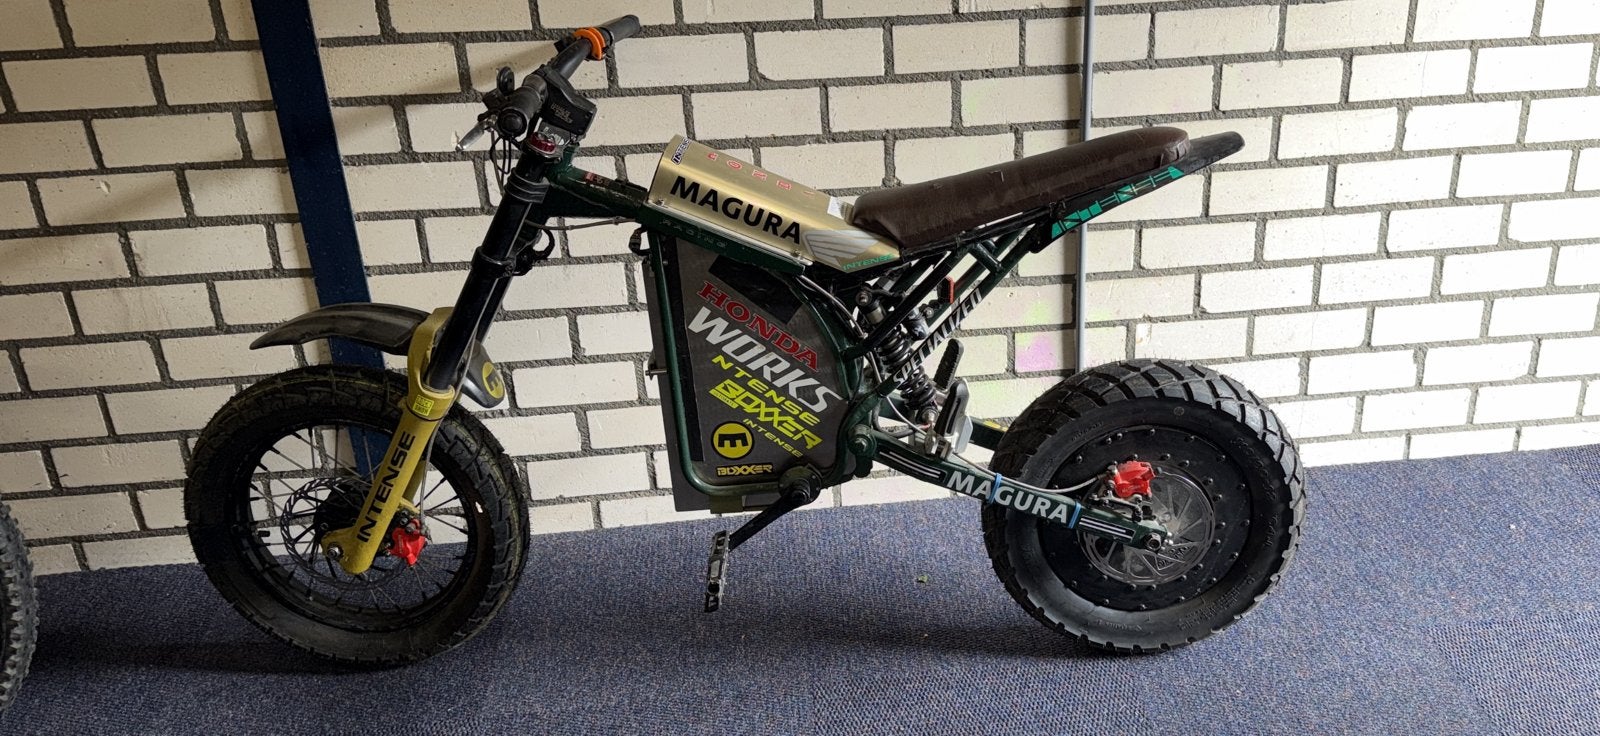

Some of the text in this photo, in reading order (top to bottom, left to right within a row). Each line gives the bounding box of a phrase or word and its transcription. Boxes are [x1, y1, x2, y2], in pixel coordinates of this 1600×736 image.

[670, 175, 801, 245] MAGURA
[843, 252, 895, 271] INTENSE
[697, 281, 819, 372] HONDA
[687, 306, 844, 413] WORKS
[742, 418, 804, 458] INTENSE
[357, 431, 416, 543] INTENSE
[716, 464, 773, 476] BOXXER
[947, 470, 1068, 524] MAGURA
